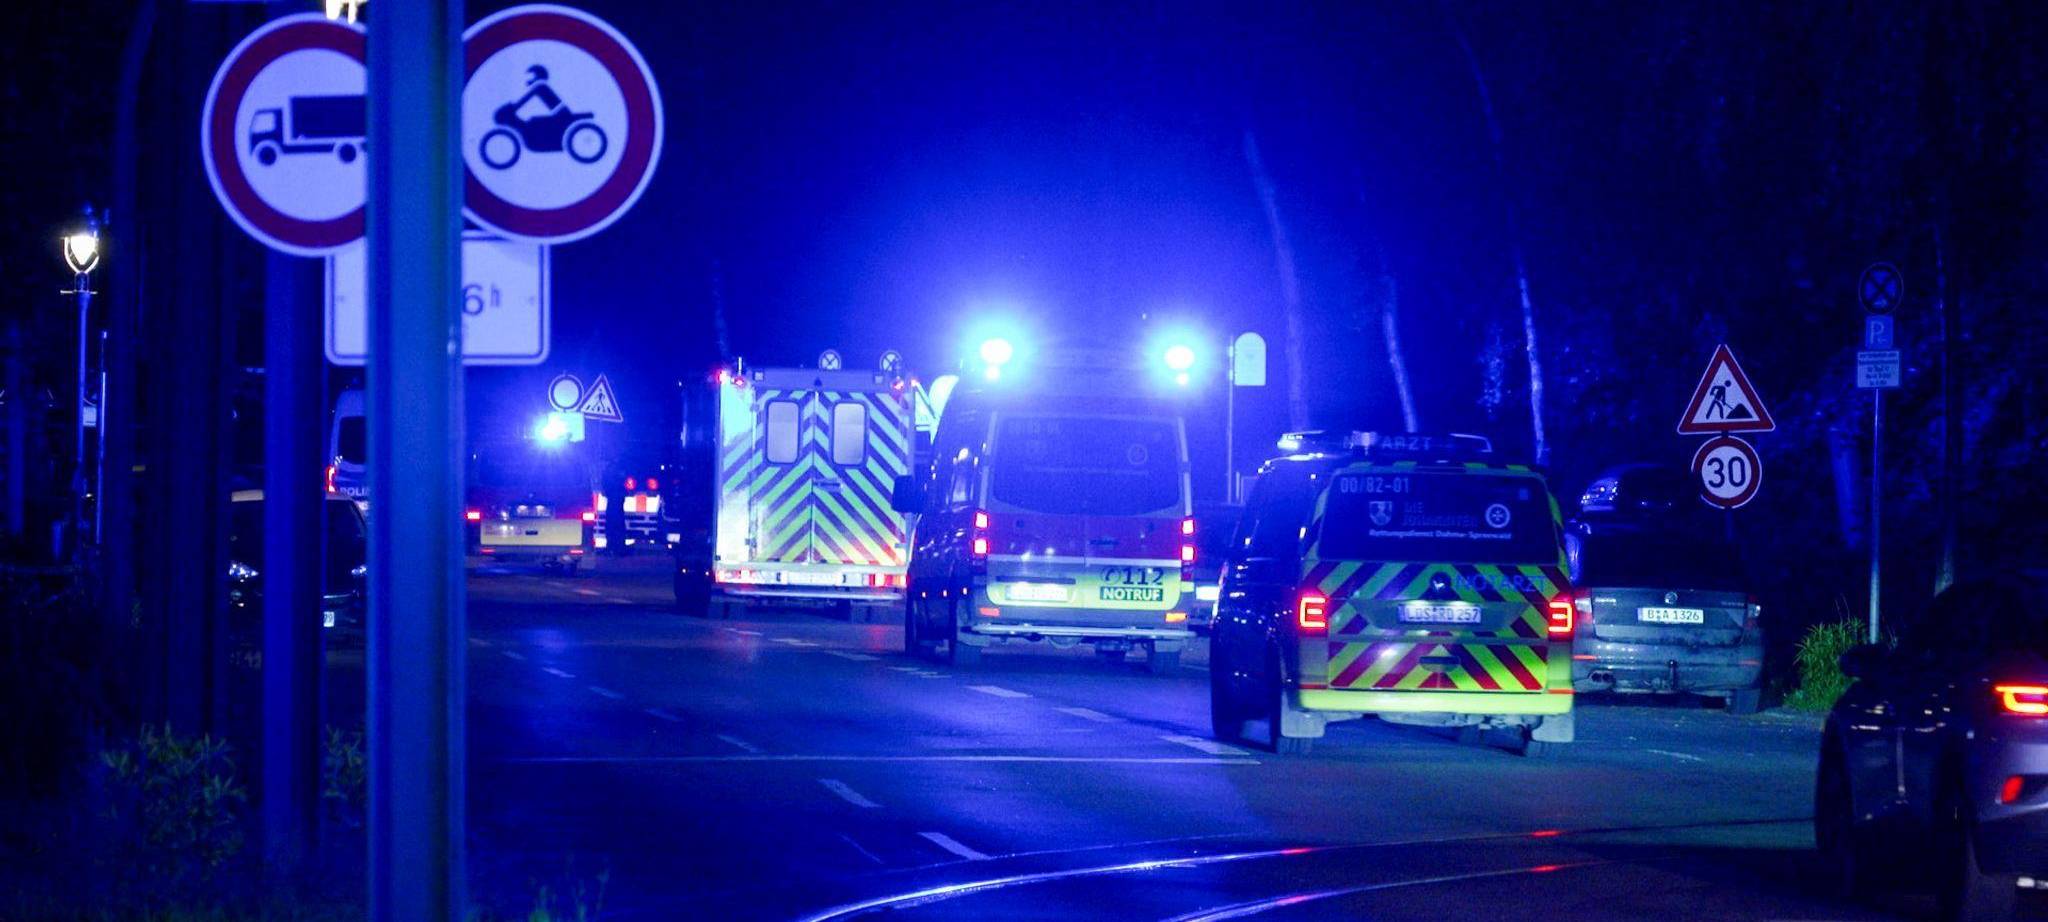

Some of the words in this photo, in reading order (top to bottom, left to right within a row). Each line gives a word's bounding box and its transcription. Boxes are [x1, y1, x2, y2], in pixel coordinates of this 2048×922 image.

[1707, 456, 1746, 488] 30
[1122, 567, 1164, 586] 112
[1102, 587, 1162, 600] NOTRUF
[1456, 608, 1479, 622] 257
[1673, 610, 1700, 620] 1326
